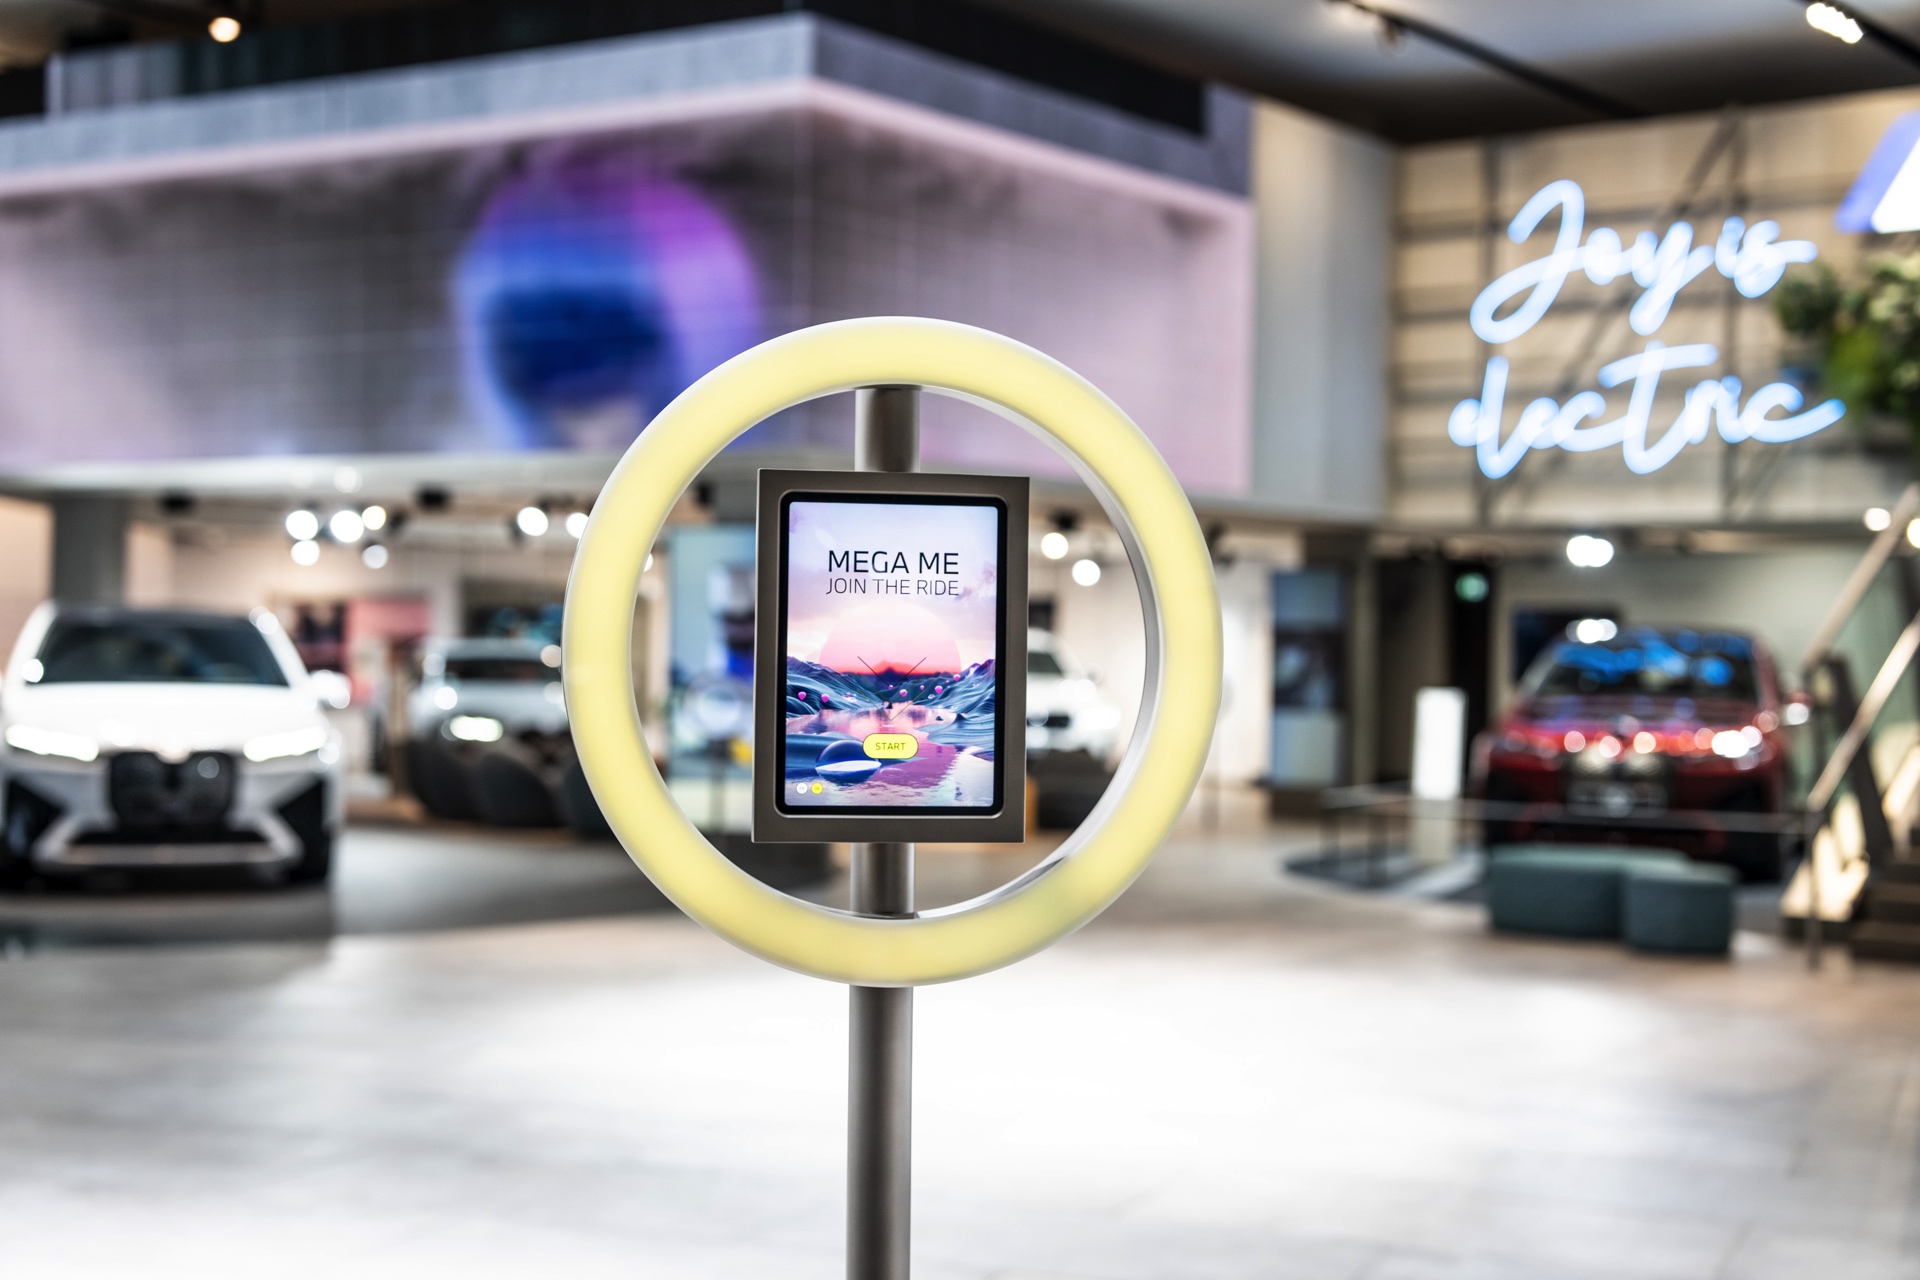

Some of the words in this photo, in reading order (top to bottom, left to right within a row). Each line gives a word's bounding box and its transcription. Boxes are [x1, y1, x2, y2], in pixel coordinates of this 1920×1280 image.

[1470, 179, 1715, 344] Joy
[1714, 216, 1818, 298] is
[1448, 340, 1846, 479] electric
[828, 549, 909, 575] MEGA
[918, 553, 959, 575] ME
[825, 577, 867, 595] JOIN
[872, 578, 910, 595] THE
[916, 579, 959, 596] RIDE
[875, 742, 906, 751] START
